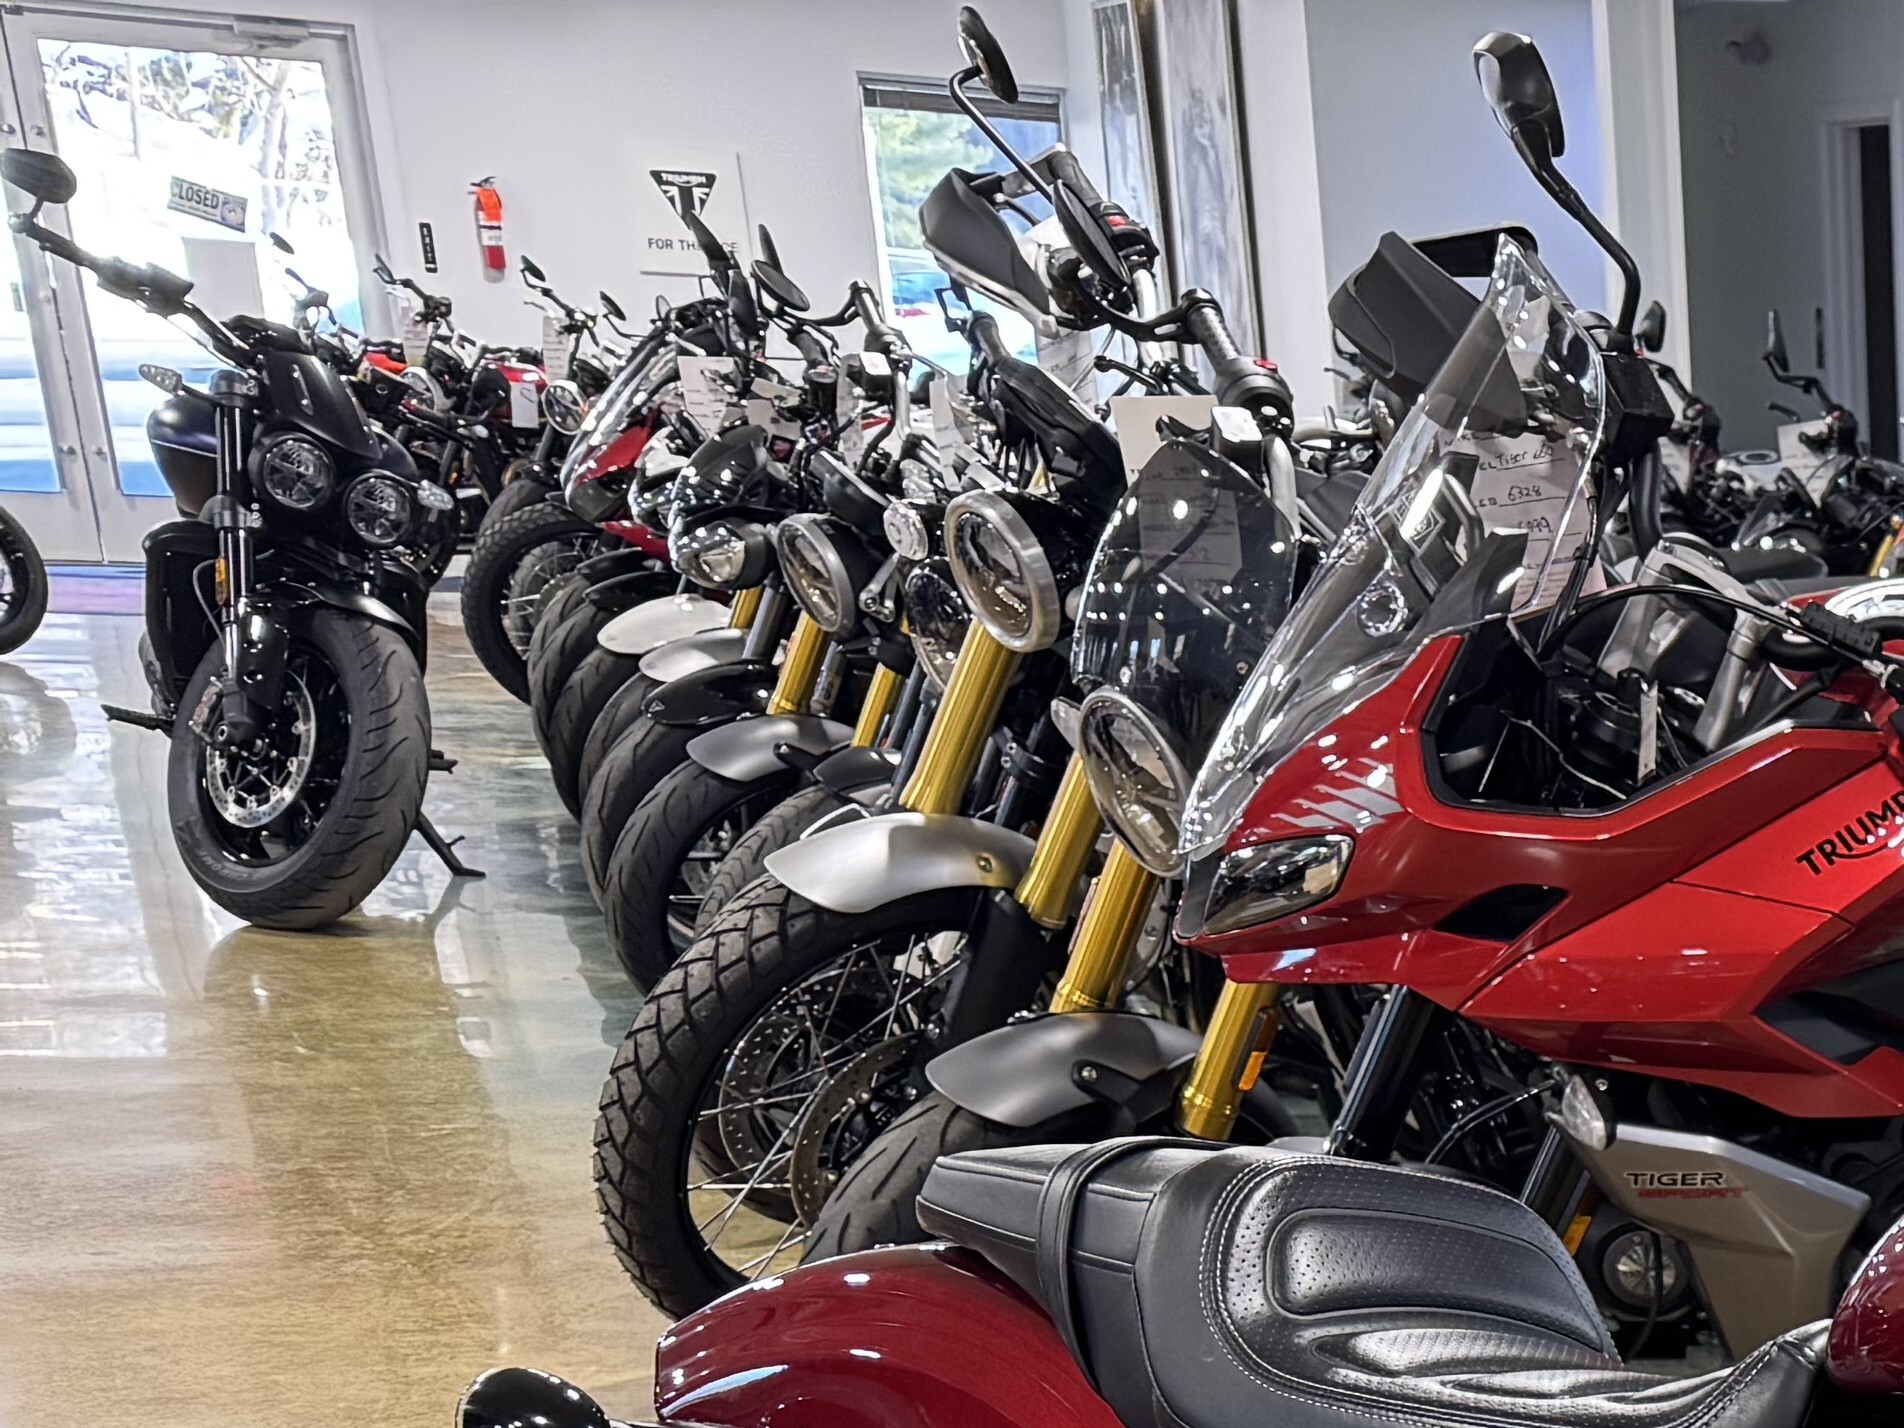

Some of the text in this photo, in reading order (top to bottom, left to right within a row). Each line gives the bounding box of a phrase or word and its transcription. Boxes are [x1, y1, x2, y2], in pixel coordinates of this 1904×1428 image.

[647, 237, 673, 250] FOR
[678, 239, 698, 251] TH
[1626, 1172, 1725, 1187] TIGER
